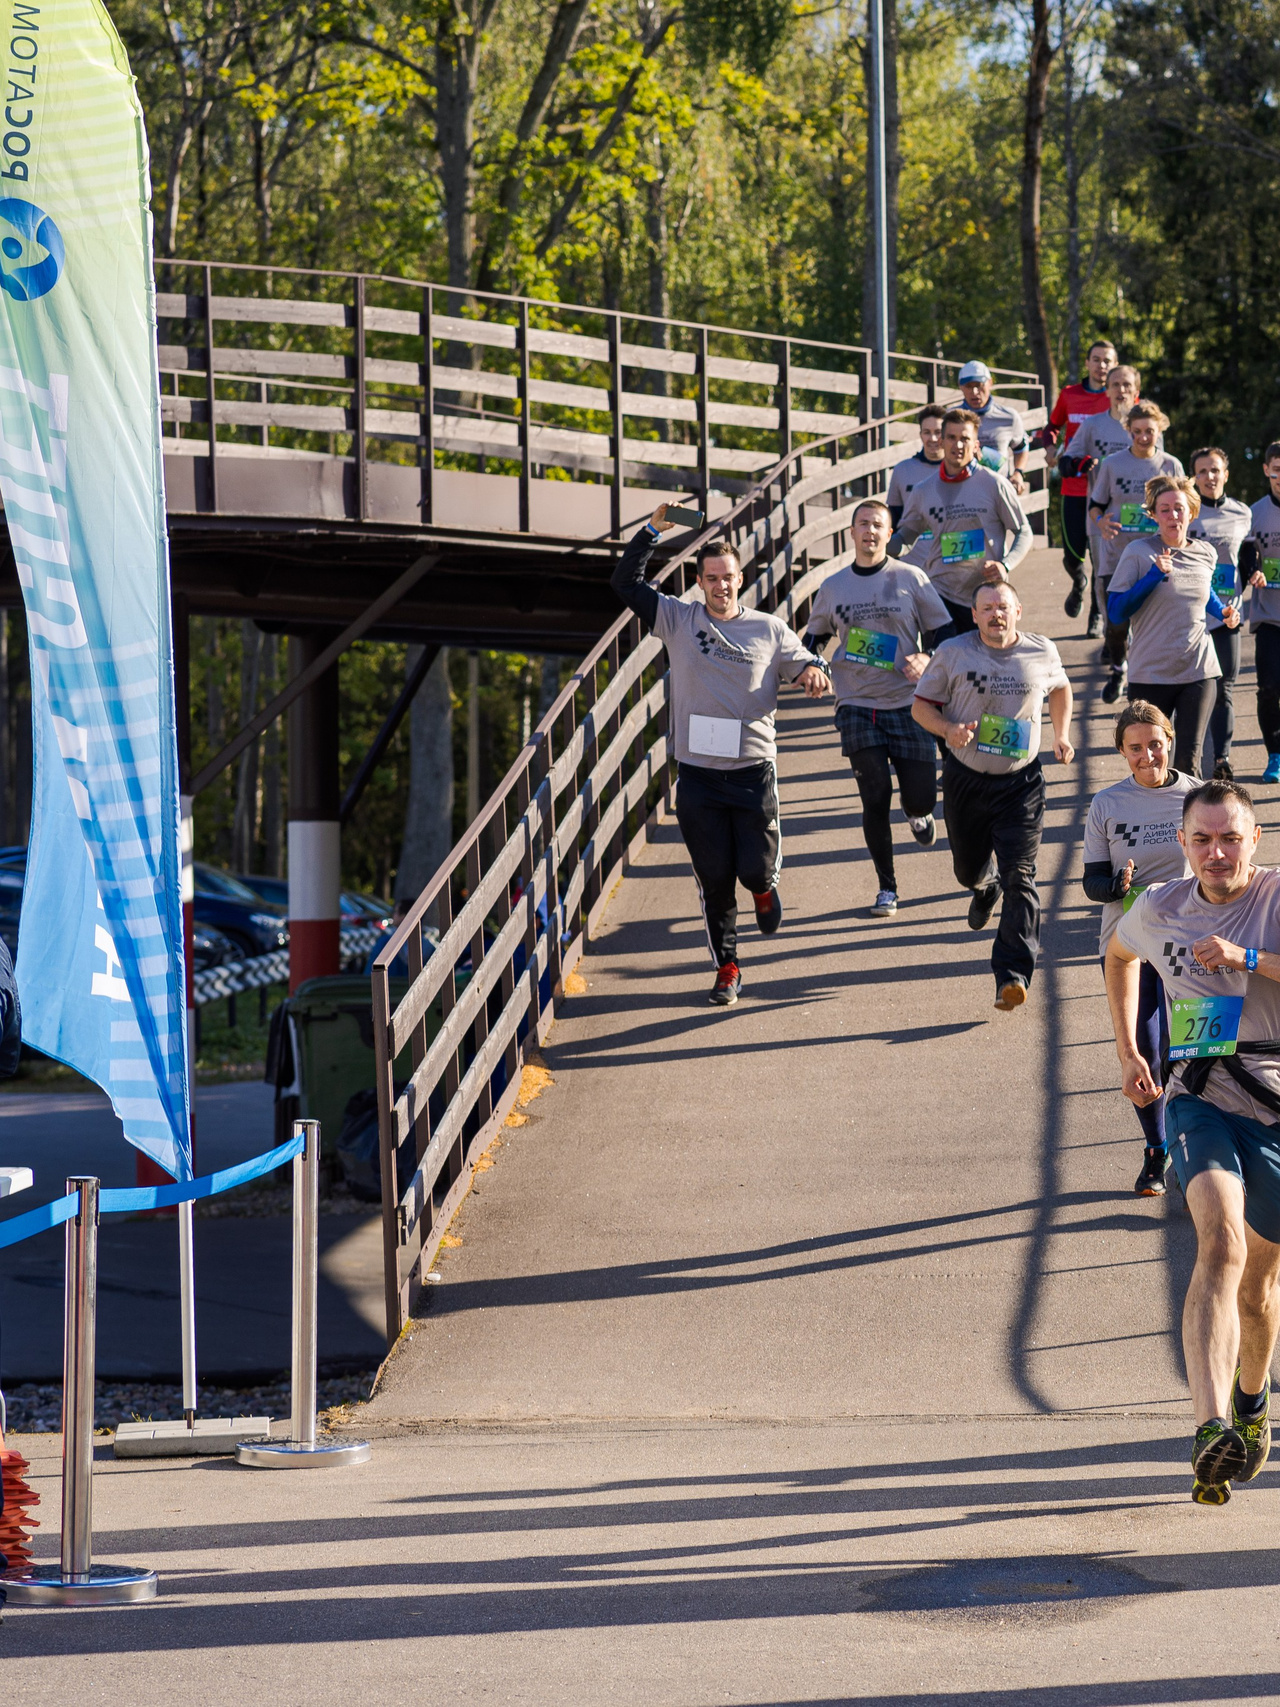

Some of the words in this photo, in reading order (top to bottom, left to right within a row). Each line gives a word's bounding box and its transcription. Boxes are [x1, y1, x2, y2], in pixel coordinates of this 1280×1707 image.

[951, 540, 974, 555] 271
[1211, 573, 1226, 586] 69
[856, 639, 885, 658] 265
[989, 728, 1020, 747] 262
[1143, 822, 1176, 831] ГОНКА
[1143, 828, 1177, 839] ДИВИЗ
[1143, 836, 1179, 845] РОСАТО
[1183, 1015, 1222, 1042] 276
